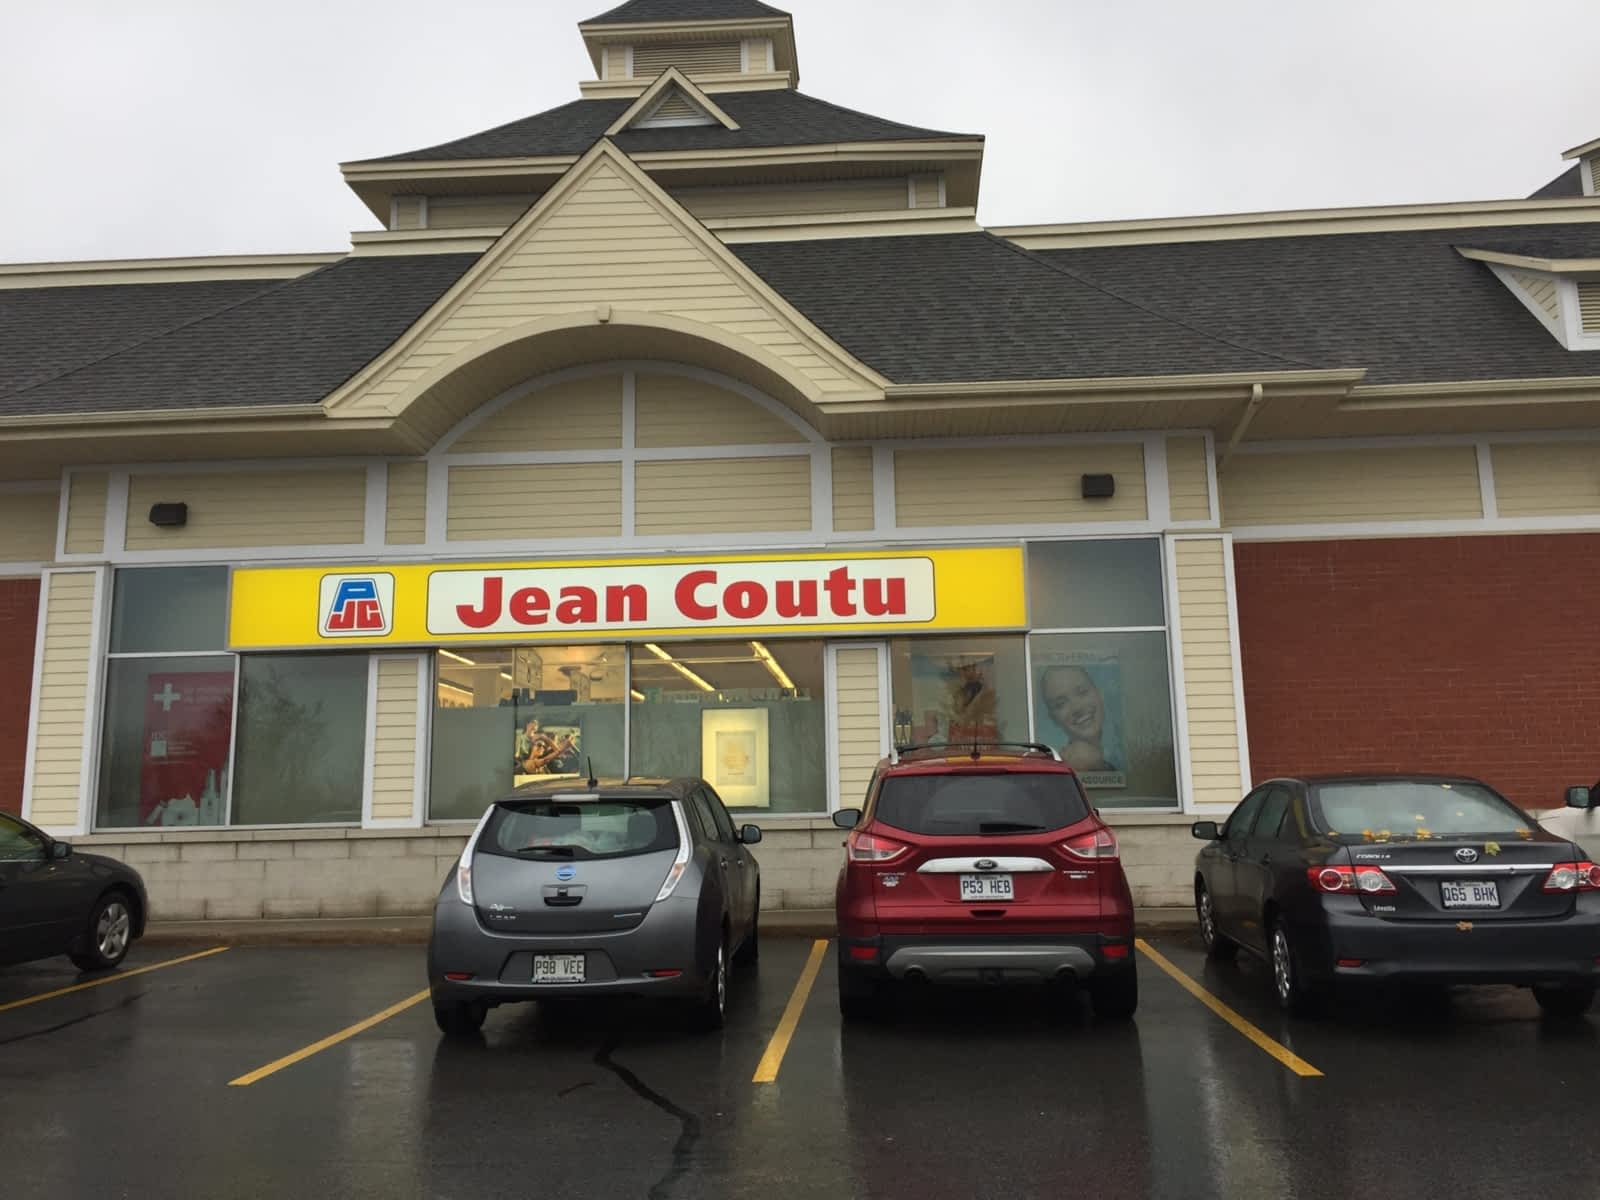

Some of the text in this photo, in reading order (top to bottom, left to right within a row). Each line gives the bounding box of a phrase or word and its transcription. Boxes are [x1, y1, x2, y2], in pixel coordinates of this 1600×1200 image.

[456, 566, 907, 628] Jean Coutu
[962, 880, 1012, 894] P53 HEB
[1443, 887, 1497, 901] Q65 BHK
[535, 960, 585, 975] P98 VEE
